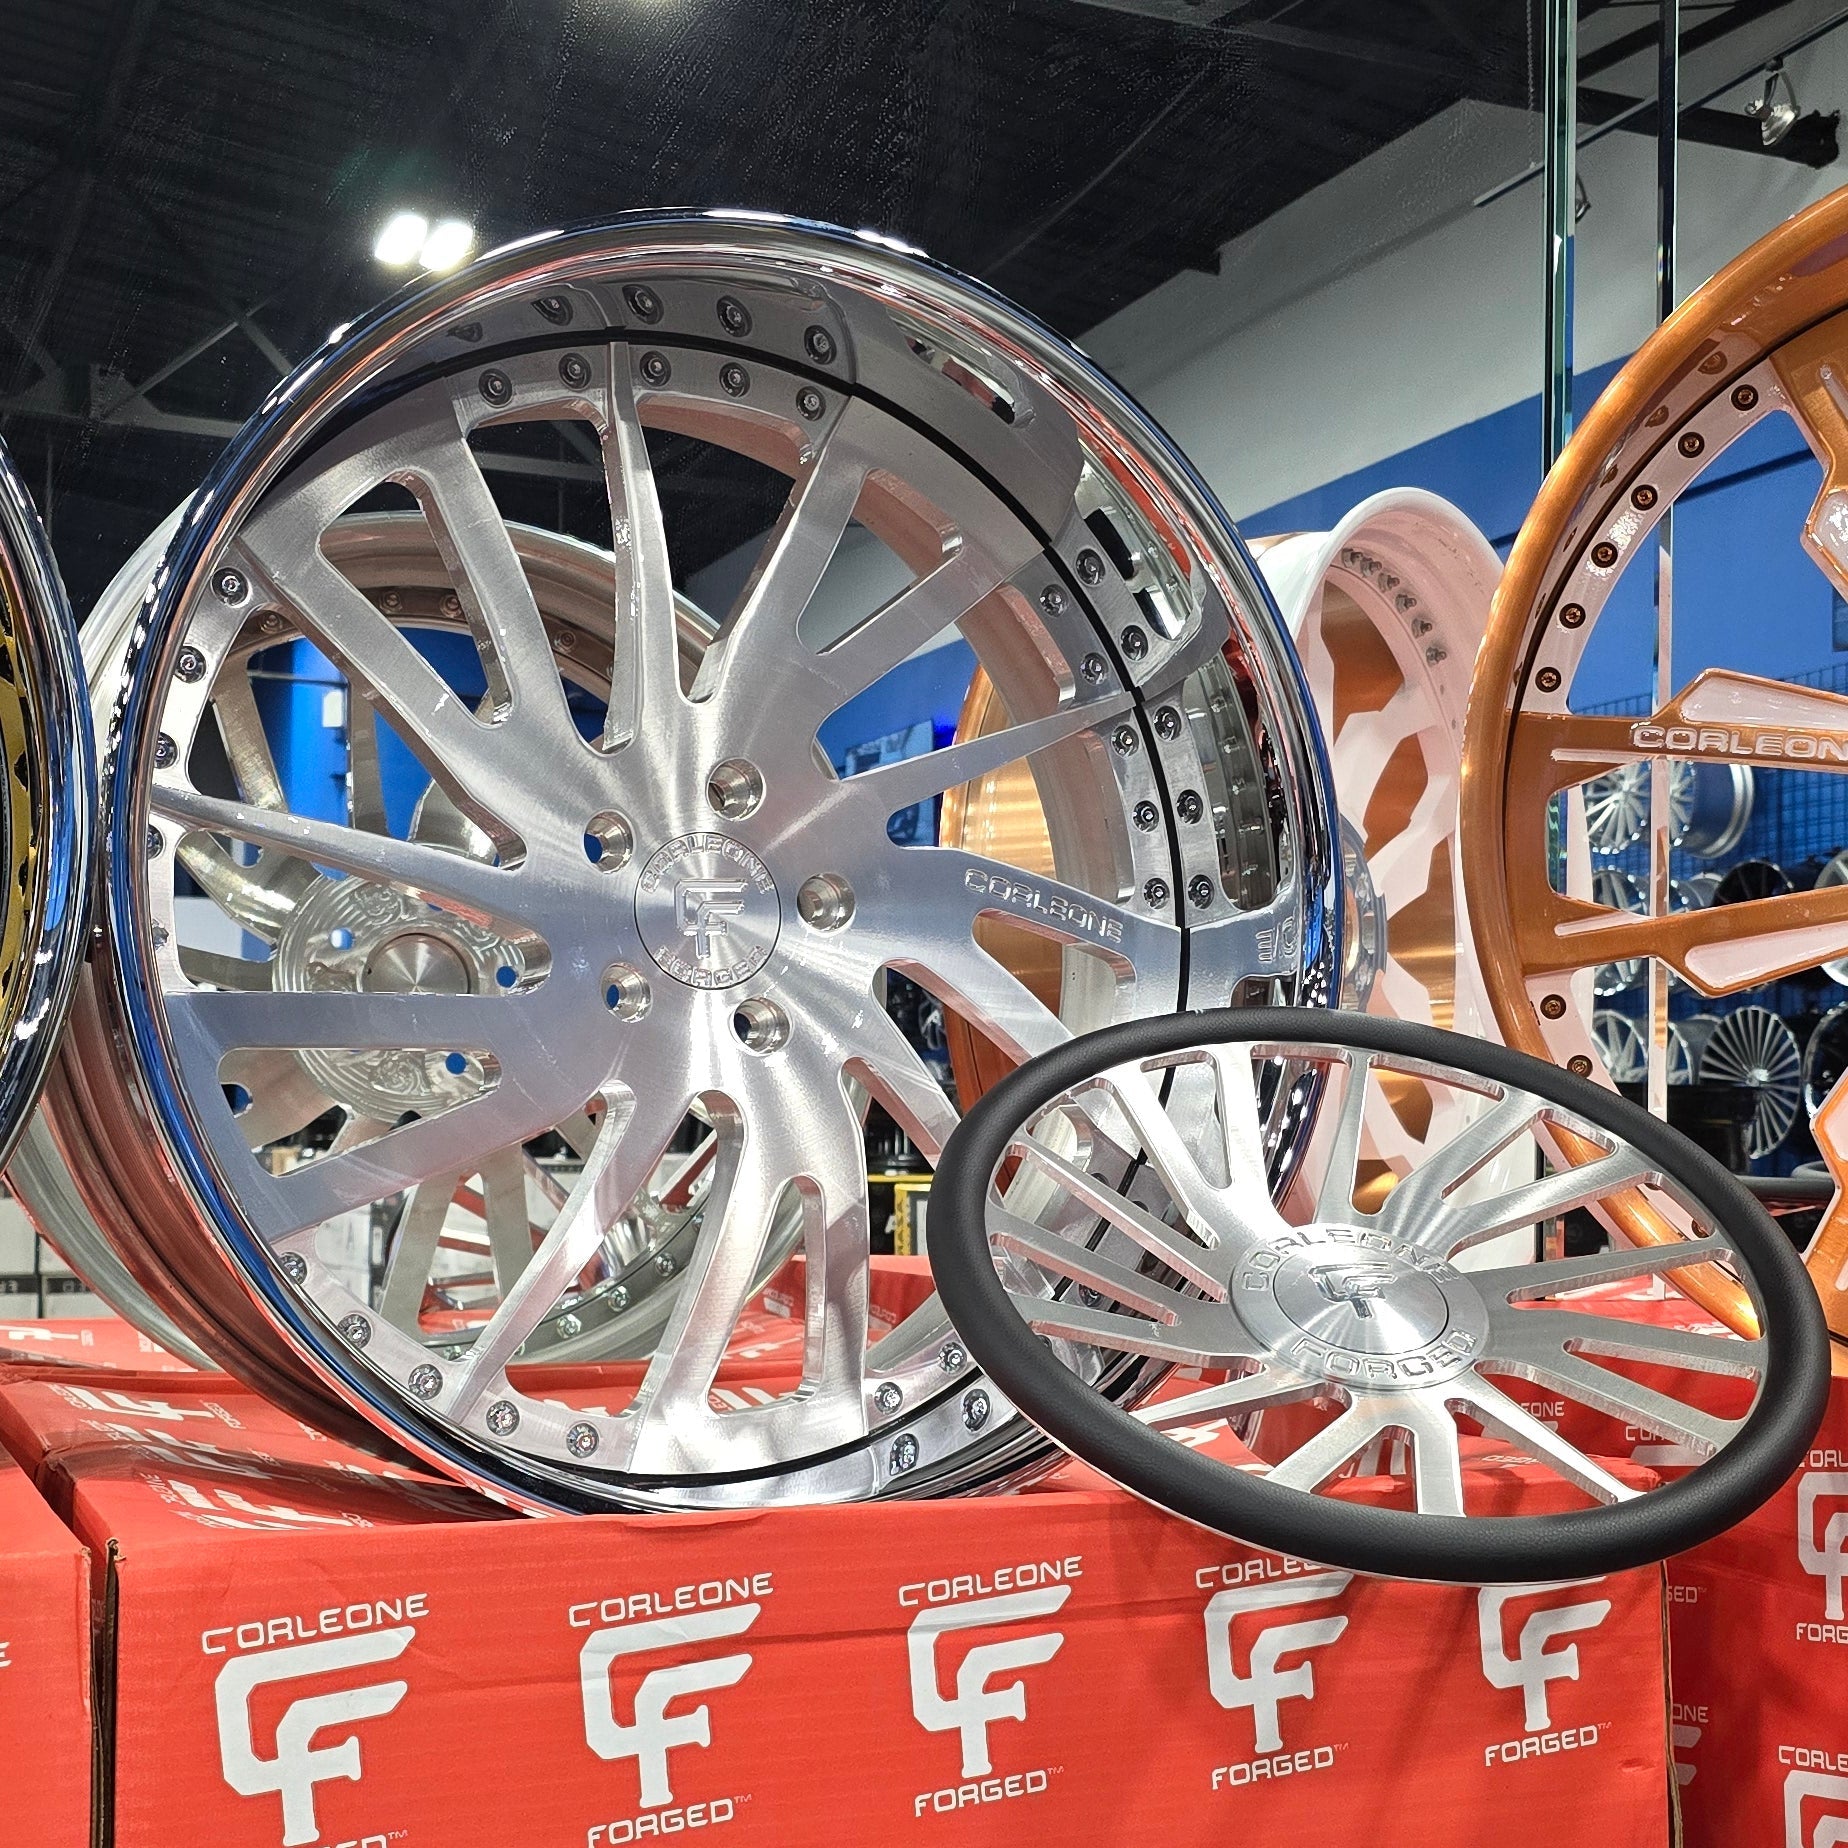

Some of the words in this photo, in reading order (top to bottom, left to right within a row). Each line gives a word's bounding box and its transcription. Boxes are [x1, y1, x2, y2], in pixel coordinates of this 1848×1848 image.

[964, 868, 1124, 943] CORLEONE
[1242, 1227, 1459, 1291] CORLEONE
[1290, 1327, 1477, 1380] FORGED
[569, 1572, 774, 1628] CORLEONE
[899, 1555, 1083, 1606] CORLEONE
[201, 1593, 429, 1655] CORLEONE
